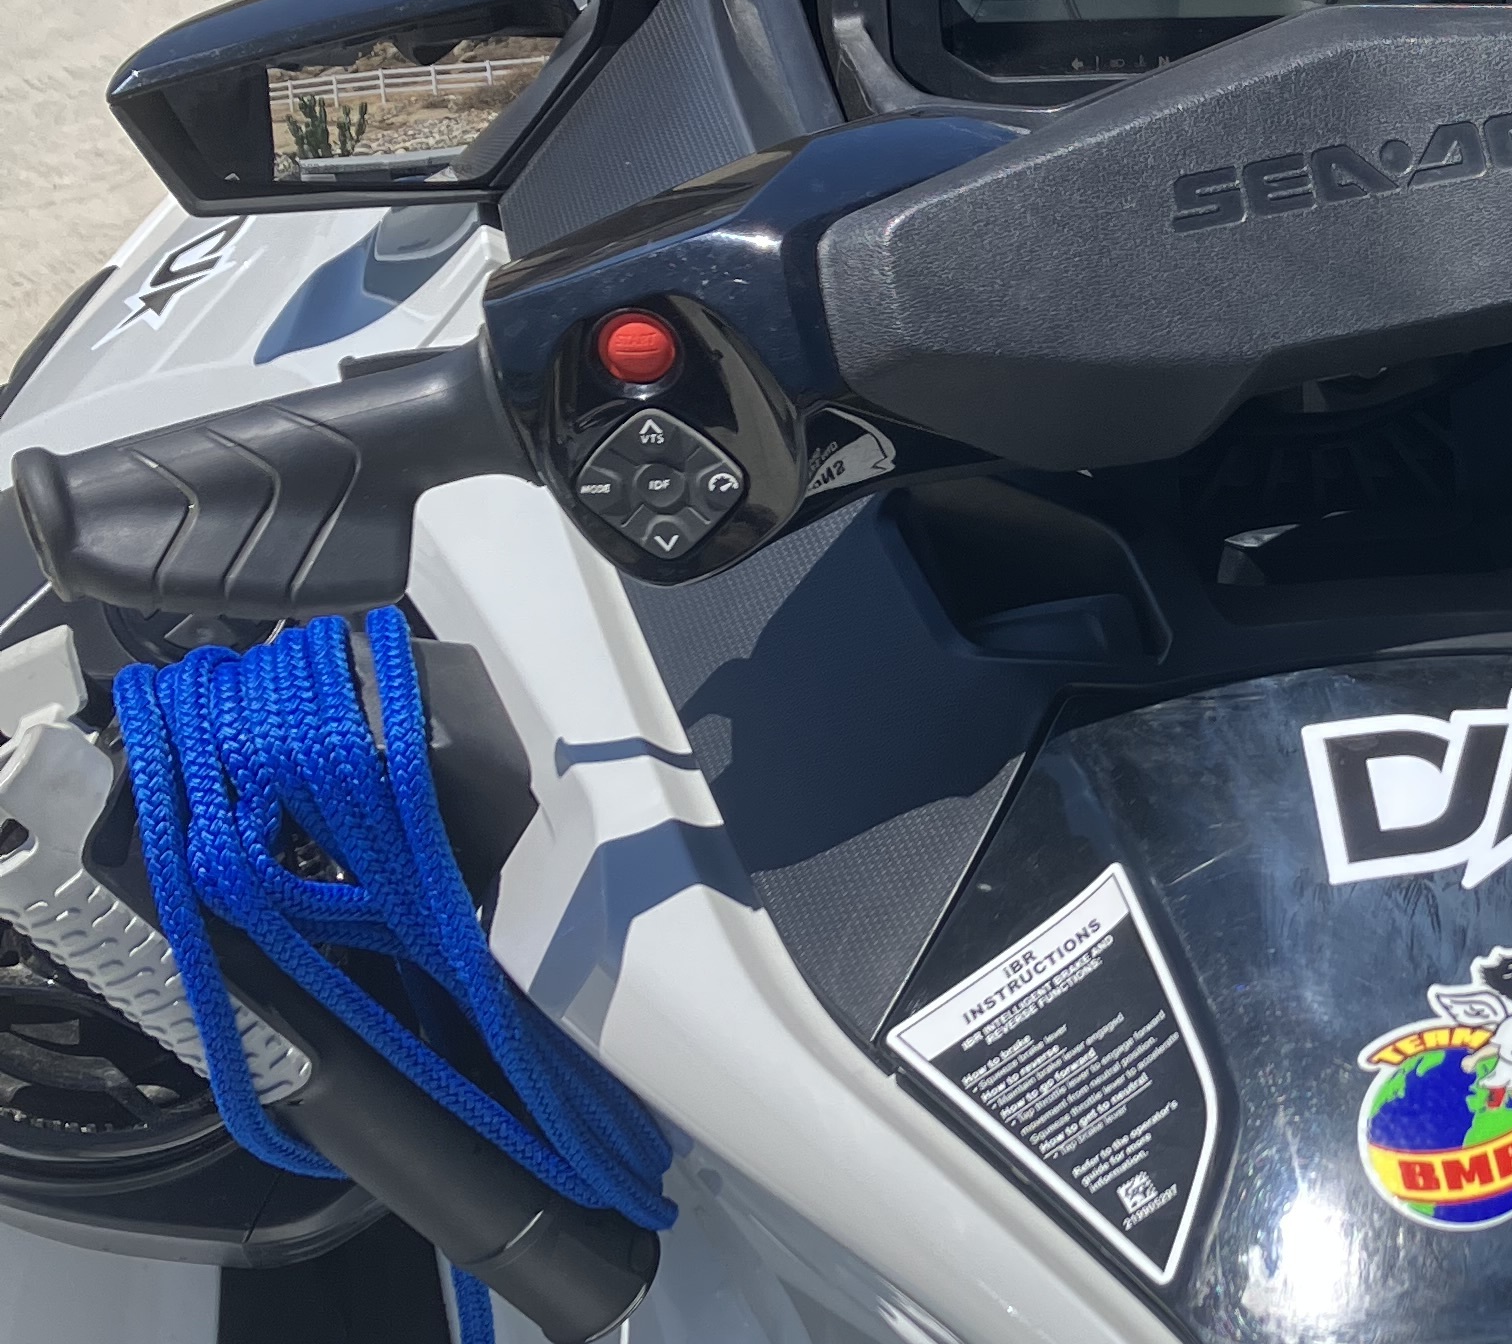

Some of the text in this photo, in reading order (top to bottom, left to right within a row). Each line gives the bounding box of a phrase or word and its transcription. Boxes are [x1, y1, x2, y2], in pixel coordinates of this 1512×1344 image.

[639, 433, 665, 445] VTS
[580, 483, 612, 494] MODE
[963, 919, 1100, 1023] INSTRUCTIONS
[982, 982, 1053, 1034] INTELLIGENT
[1052, 954, 1091, 984] BRAKE
[1089, 935, 1113, 956] AND
[985, 1004, 1037, 1044] REVERSE
[1000, 1034, 1030, 1058] brake
[1367, 1026, 1494, 1065] TEAM
[981, 1081, 1006, 1101] How
[1006, 1072, 1019, 1083] to
[1000, 1048, 1095, 1118] How to go forward
[1039, 1131, 1065, 1152] How
[1065, 1123, 1077, 1134] to
[1077, 1109, 1097, 1127] get
[1096, 1101, 1109, 1112] to
[1071, 1153, 1100, 1177] Refer
[1100, 1146, 1112, 1157] to
[1111, 1134, 1129, 1149] the
[1080, 1161, 1110, 1186] guide
[1109, 1150, 1126, 1164] for
